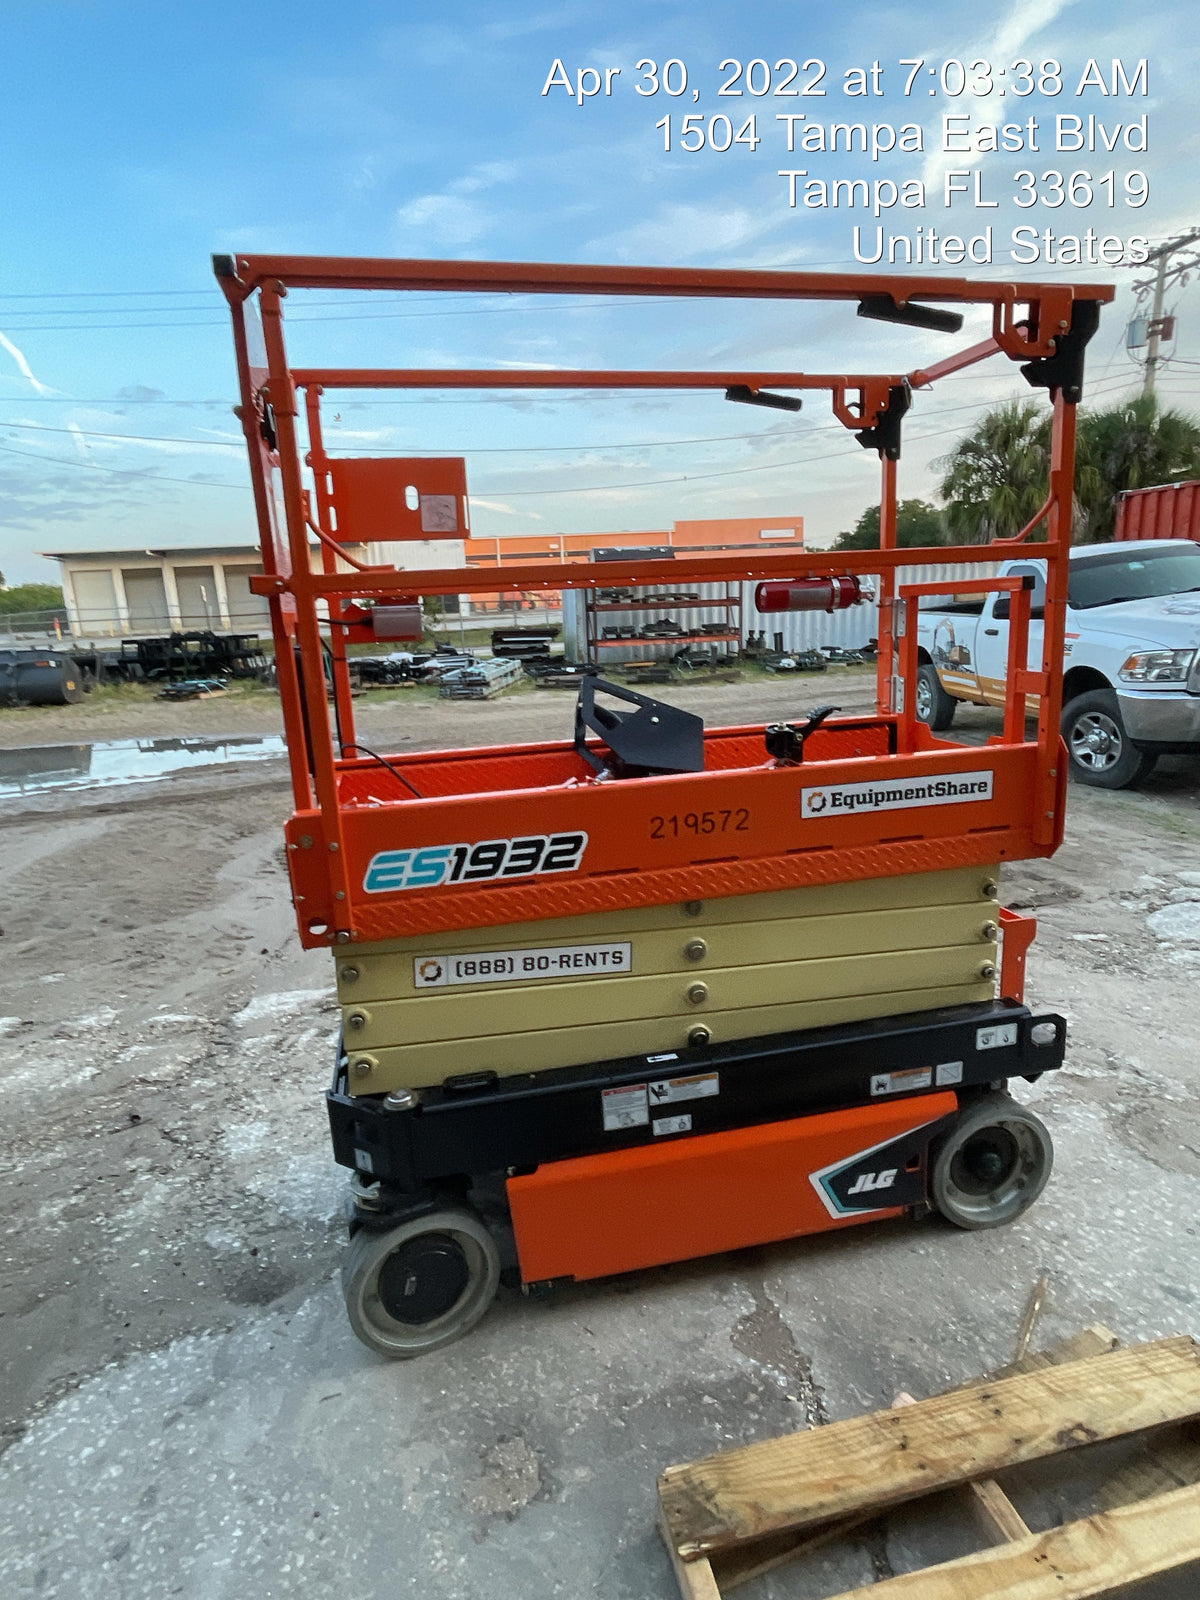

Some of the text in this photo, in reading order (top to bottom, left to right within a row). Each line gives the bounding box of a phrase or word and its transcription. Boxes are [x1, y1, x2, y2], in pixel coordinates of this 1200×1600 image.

[830, 778, 988, 810] EquipmentShare
[650, 808, 750, 839] 219572
[365, 833, 586, 891] ES1932
[455, 950, 624, 979] (888) 80-RENTS
[847, 1168, 899, 1195] JLG
